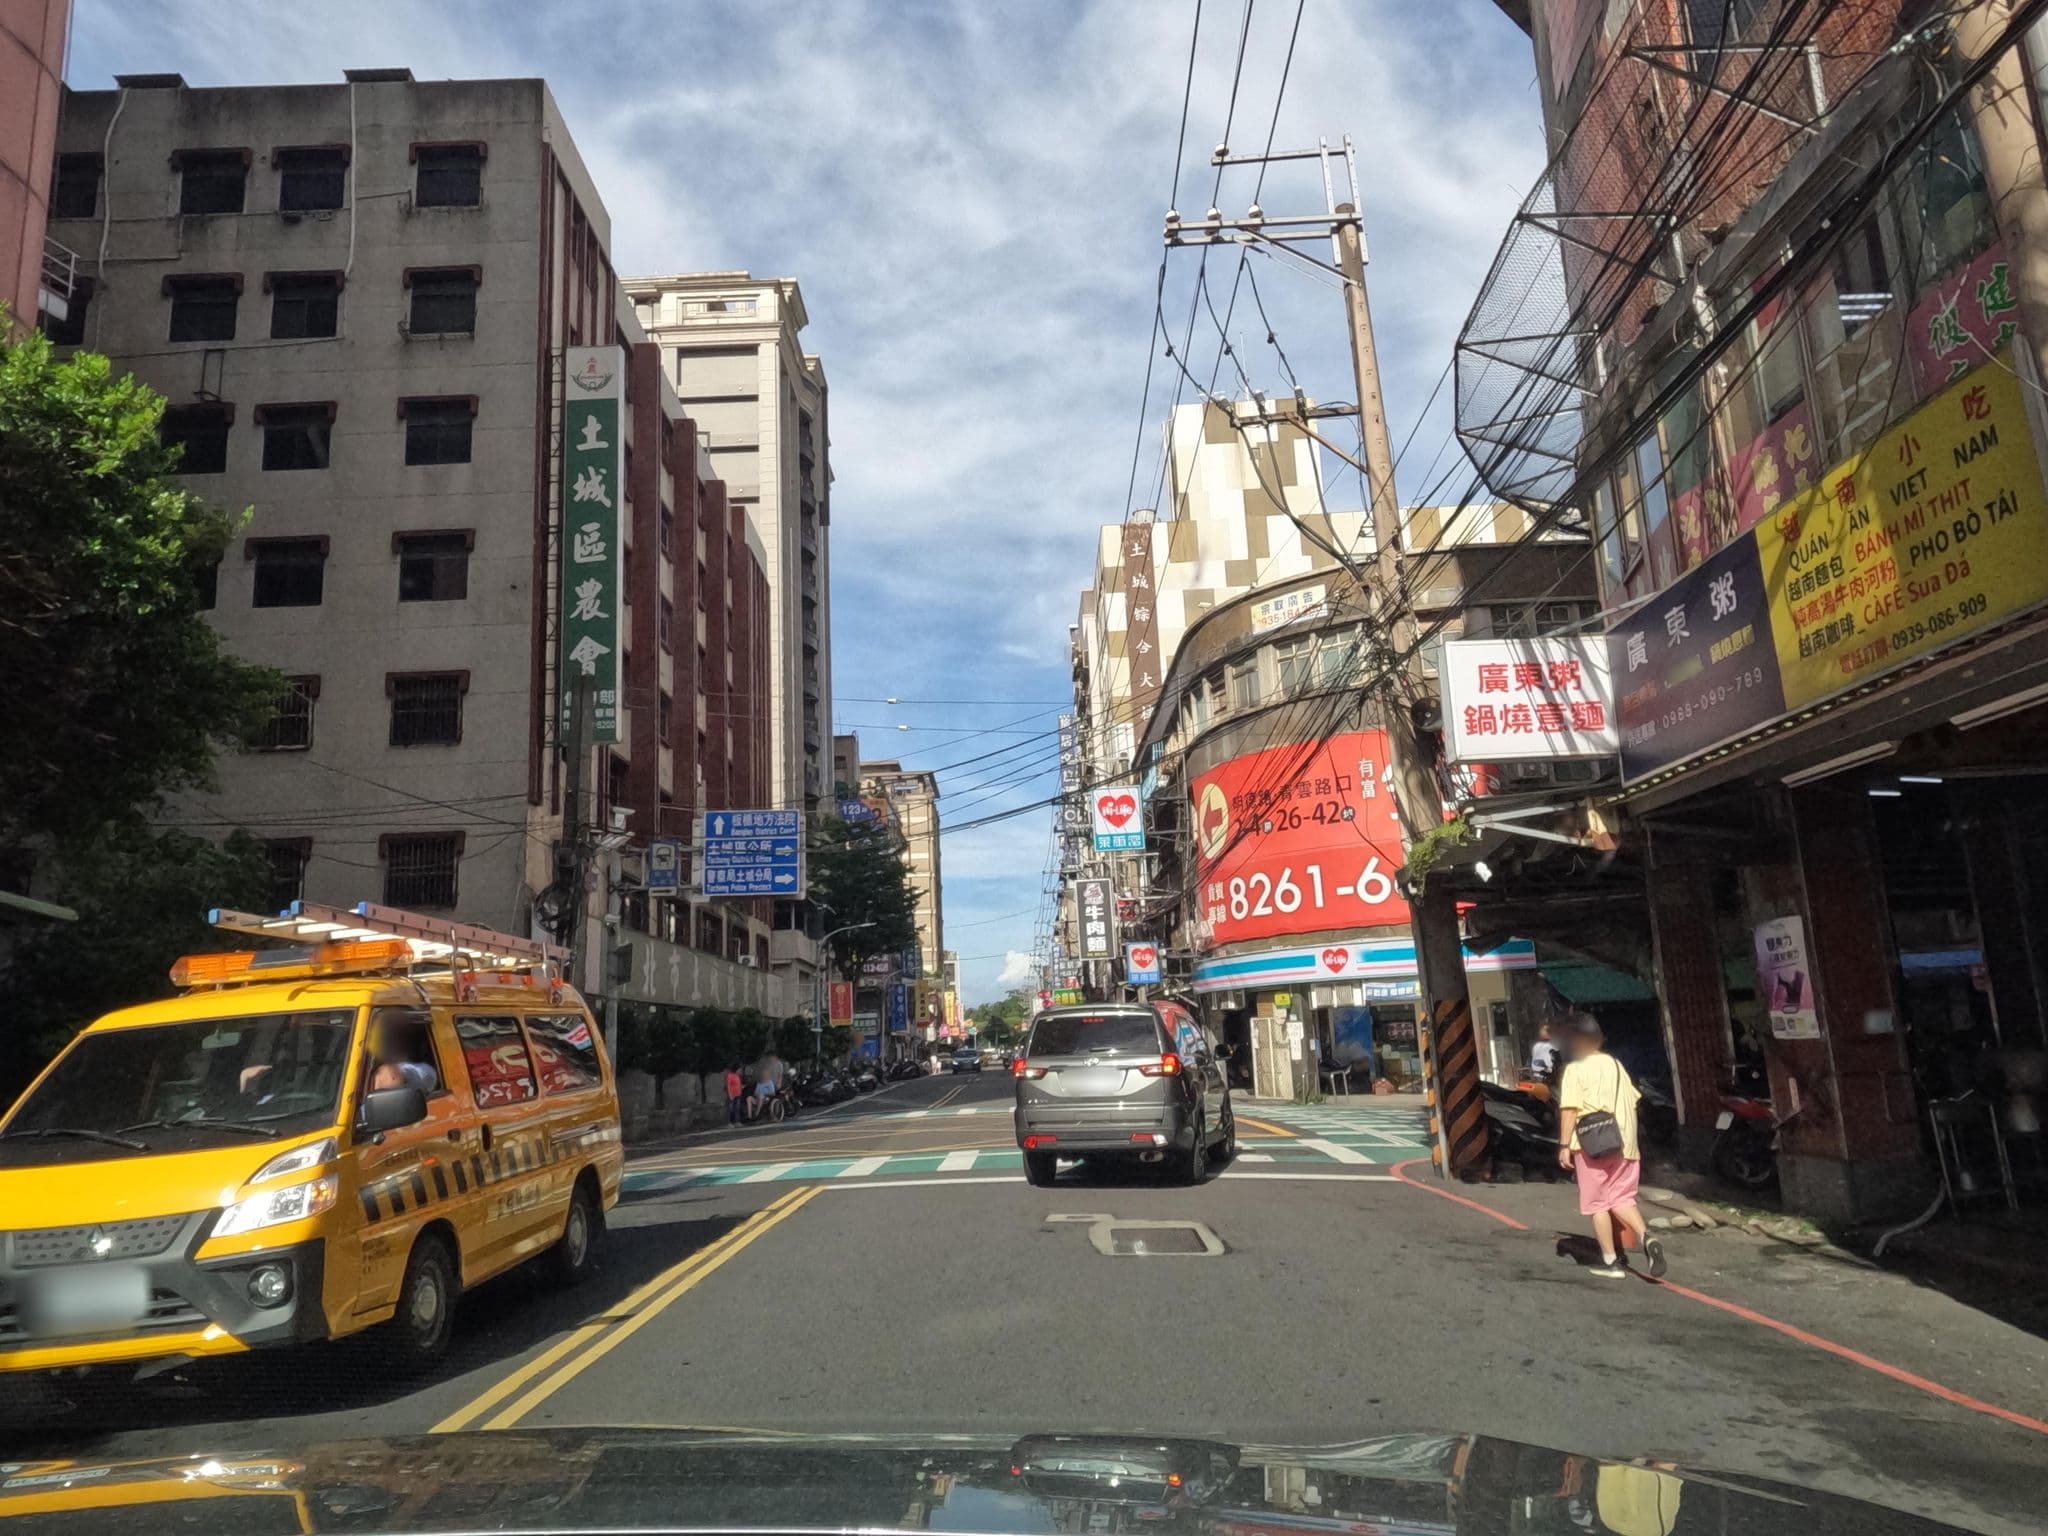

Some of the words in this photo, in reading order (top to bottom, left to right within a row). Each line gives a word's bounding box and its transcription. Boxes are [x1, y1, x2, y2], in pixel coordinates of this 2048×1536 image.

[1781, 384, 1992, 546] 越南小吃
[1789, 532, 1829, 572] QUÁN
[1850, 505, 1870, 535] ĂN
[1890, 467, 1927, 506] VIET
[1953, 424, 1998, 469] NAM
[1855, 520, 1900, 564] BÁNH
[1904, 502, 1926, 534] MÌ
[1927, 478, 1971, 519] THIT
[569, 414, 611, 677] 土城區農會
[1910, 530, 1949, 567] PHO
[1953, 508, 1982, 544] BÒ
[1984, 489, 2018, 525] TÁI
[1907, 575, 1941, 603] Sua
[1627, 571, 1737, 673] 廣東粥
[1892, 593, 1987, 651] 0939-086-909
[1478, 660, 1582, 694] 廣東粥
[1464, 701, 1605, 736] 鍋燒意麵
[842, 804, 860, 815] 123
[1102, 801, 1133, 817] Hi-Life
[1325, 953, 1346, 966] Hi-Life
